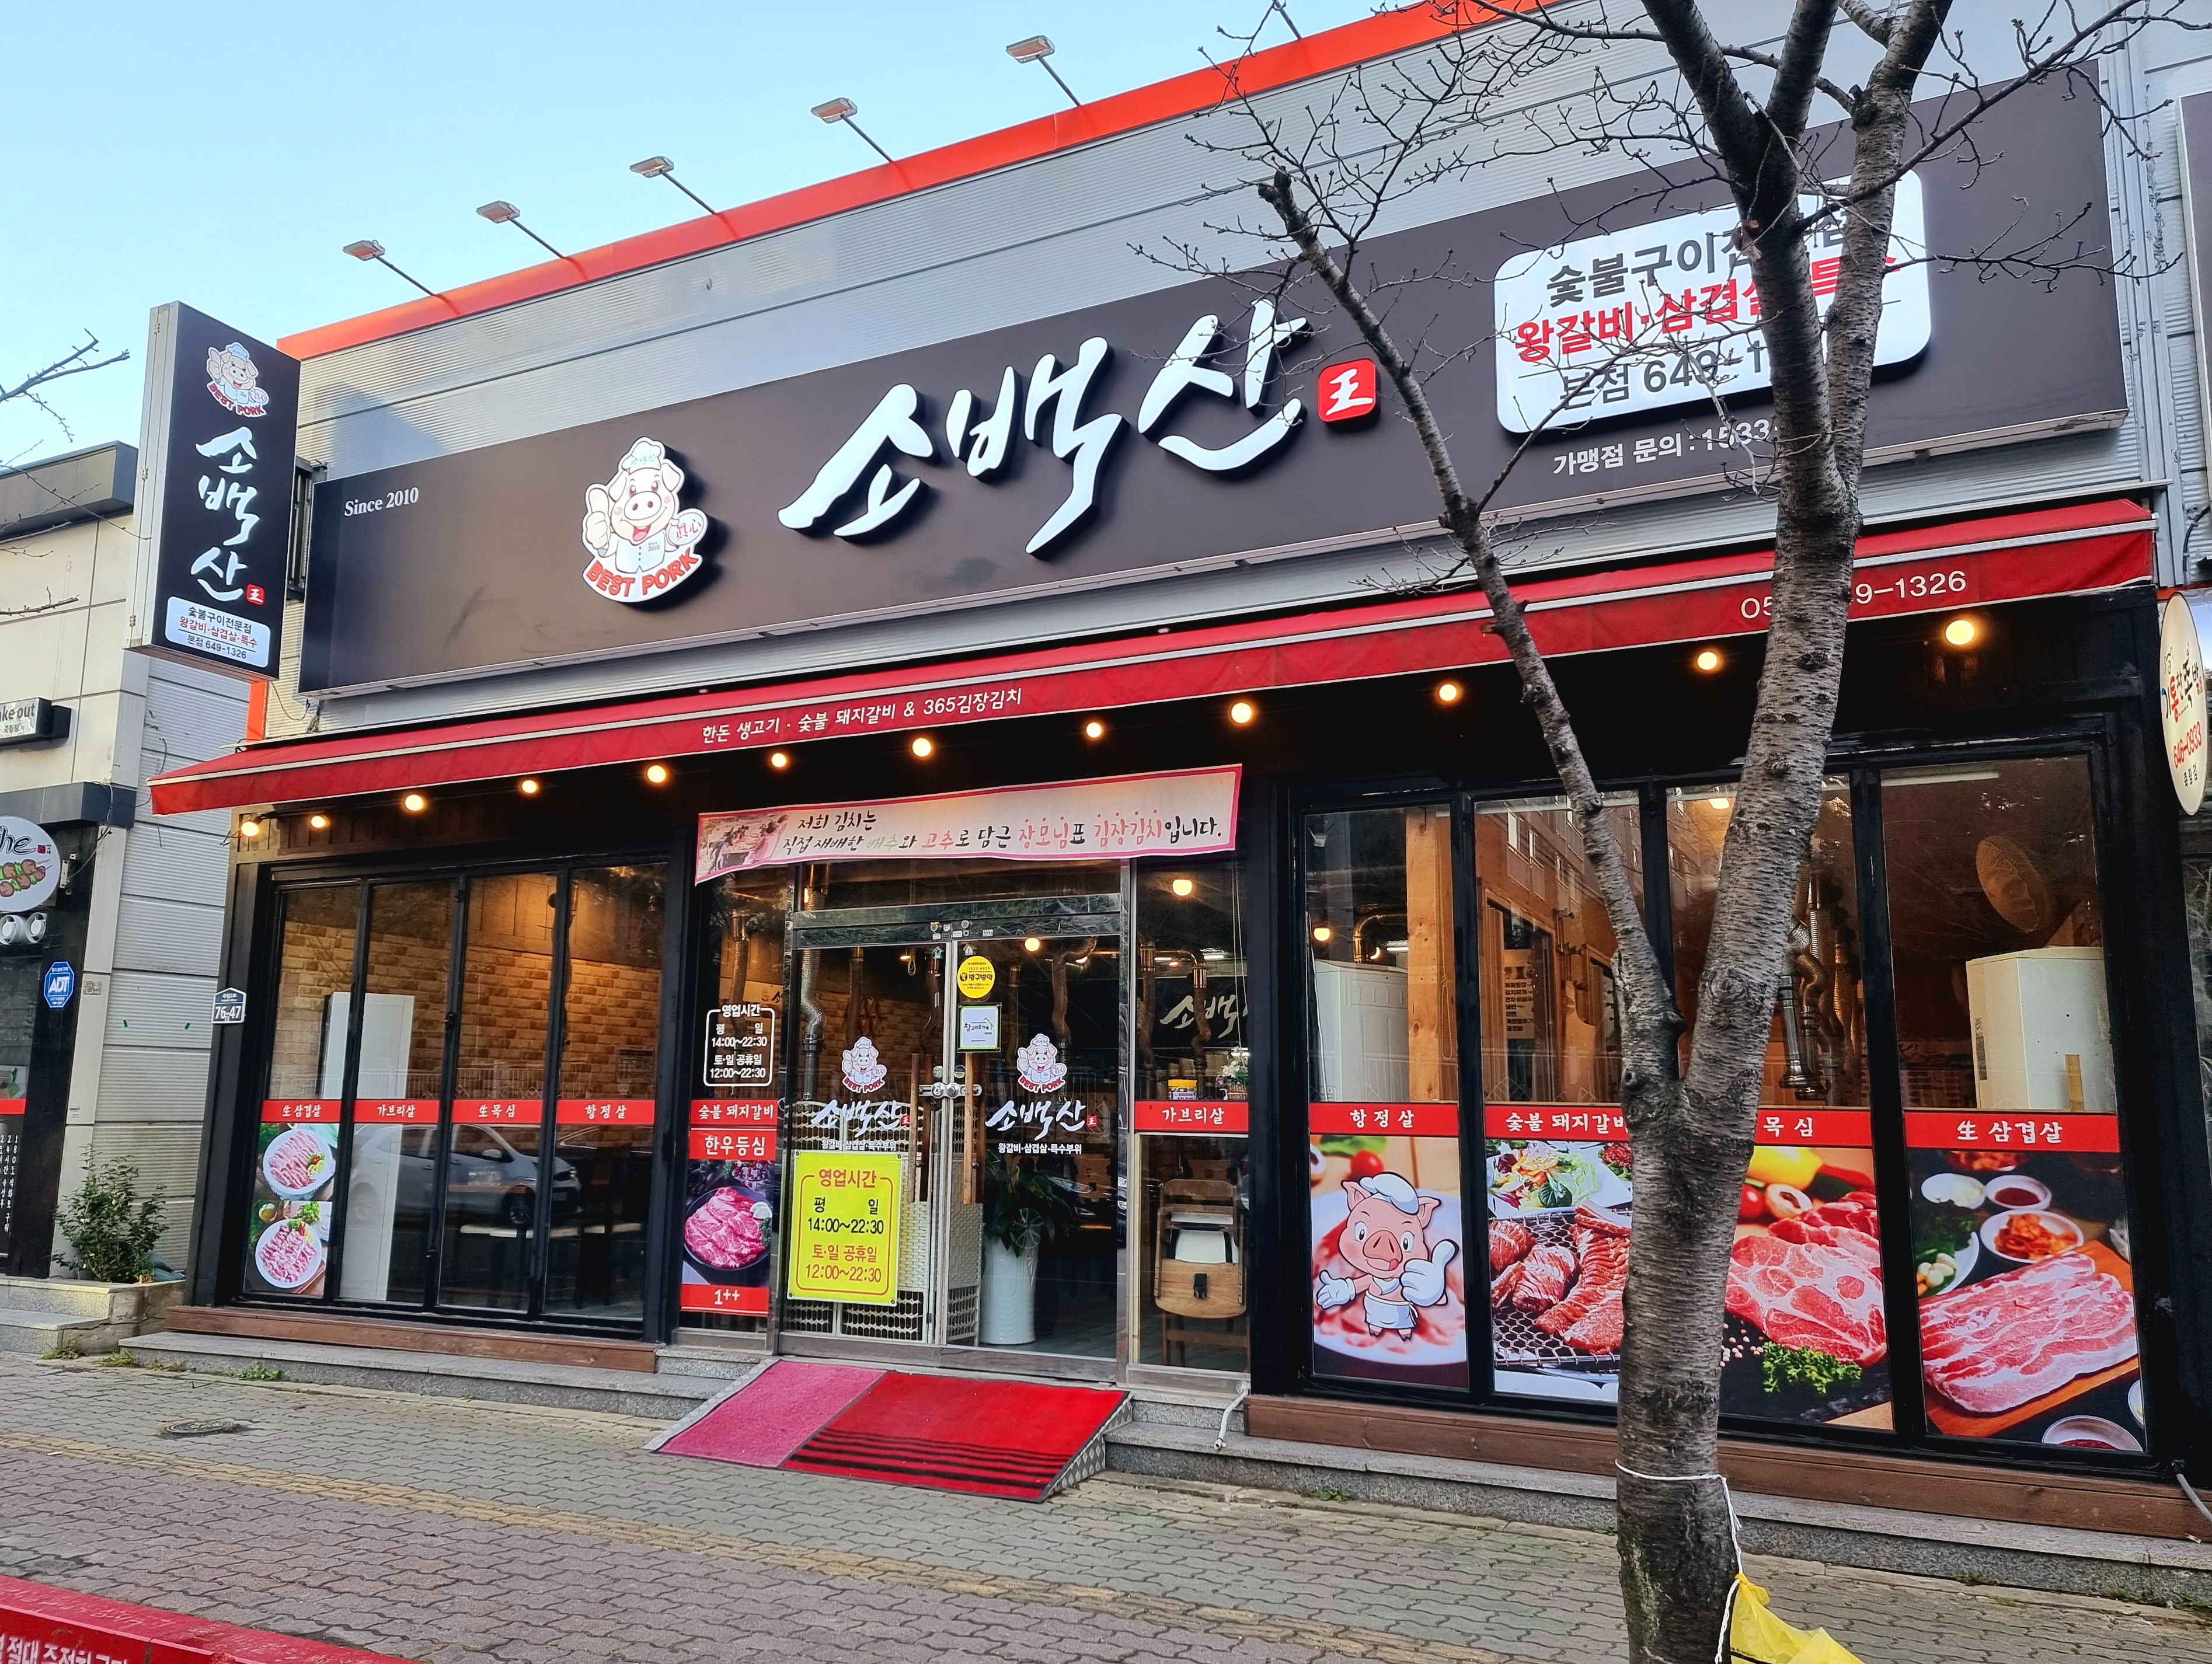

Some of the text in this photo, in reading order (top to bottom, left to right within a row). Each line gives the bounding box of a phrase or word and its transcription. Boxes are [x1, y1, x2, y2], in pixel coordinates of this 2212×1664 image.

[1560, 340, 1763, 410] 본점 649-1
[208, 383, 235, 409] BEST
[236, 404, 264, 416] PORK
[778, 298, 1309, 555] 소백산
[1553, 443, 1624, 476] 가맹점
[1633, 432, 1682, 463] 문의
[344, 486, 419, 517] Since 2010
[190, 426, 259, 602] 소백산
[586, 546, 699, 598] BEST PORK
[188, 606, 252, 634] 숯불구이전문점
[187, 634, 247, 660] 본점 649-1326
[17, 703, 36, 718] out
[702, 723, 730, 744] 한돈
[736, 717, 780, 741] 생고기
[797, 711, 828, 733] 숯불
[836, 703, 896, 725] 돼지갈비
[923, 688, 1023, 716] 365김장김치
[2173, 721, 2202, 769] 646-0933
[797, 810, 877, 831] 저희 김치는
[782, 835, 813, 856] 직접
[814, 835, 865, 852] 재배한
[921, 829, 970, 850] 고추로
[978, 825, 1012, 849] 담근
[48, 976, 70, 993] ADT
[215, 1006, 242, 1020] 76-47
[722, 1004, 761, 1018] 영업시간
[1160, 995, 1248, 1039] 소백
[711, 1036, 768, 1048] 14:00~22:30
[736, 1053, 762, 1066] 공휴일
[709, 1068, 767, 1079] 12:00~22:30
[844, 1078, 884, 1092] BEST PORK
[1019, 1077, 1064, 1092] BEST PORK
[377, 1103, 416, 1119] 가브리살
[698, 1104, 774, 1120] 숯불 돼지갈비
[810, 1099, 902, 1138] 소백산
[985, 1100, 1086, 1140] 소백산
[1161, 1107, 1225, 1125] 가브리살
[1504, 1111, 1544, 1132] 숯불
[705, 1135, 765, 1156] 한우등심
[818, 1168, 877, 1188] 영업시간
[807, 1217, 884, 1234] 14:00~22:30
[843, 1245, 877, 1263] 공휴일
[805, 1264, 882, 1283] 12:00~22:30
